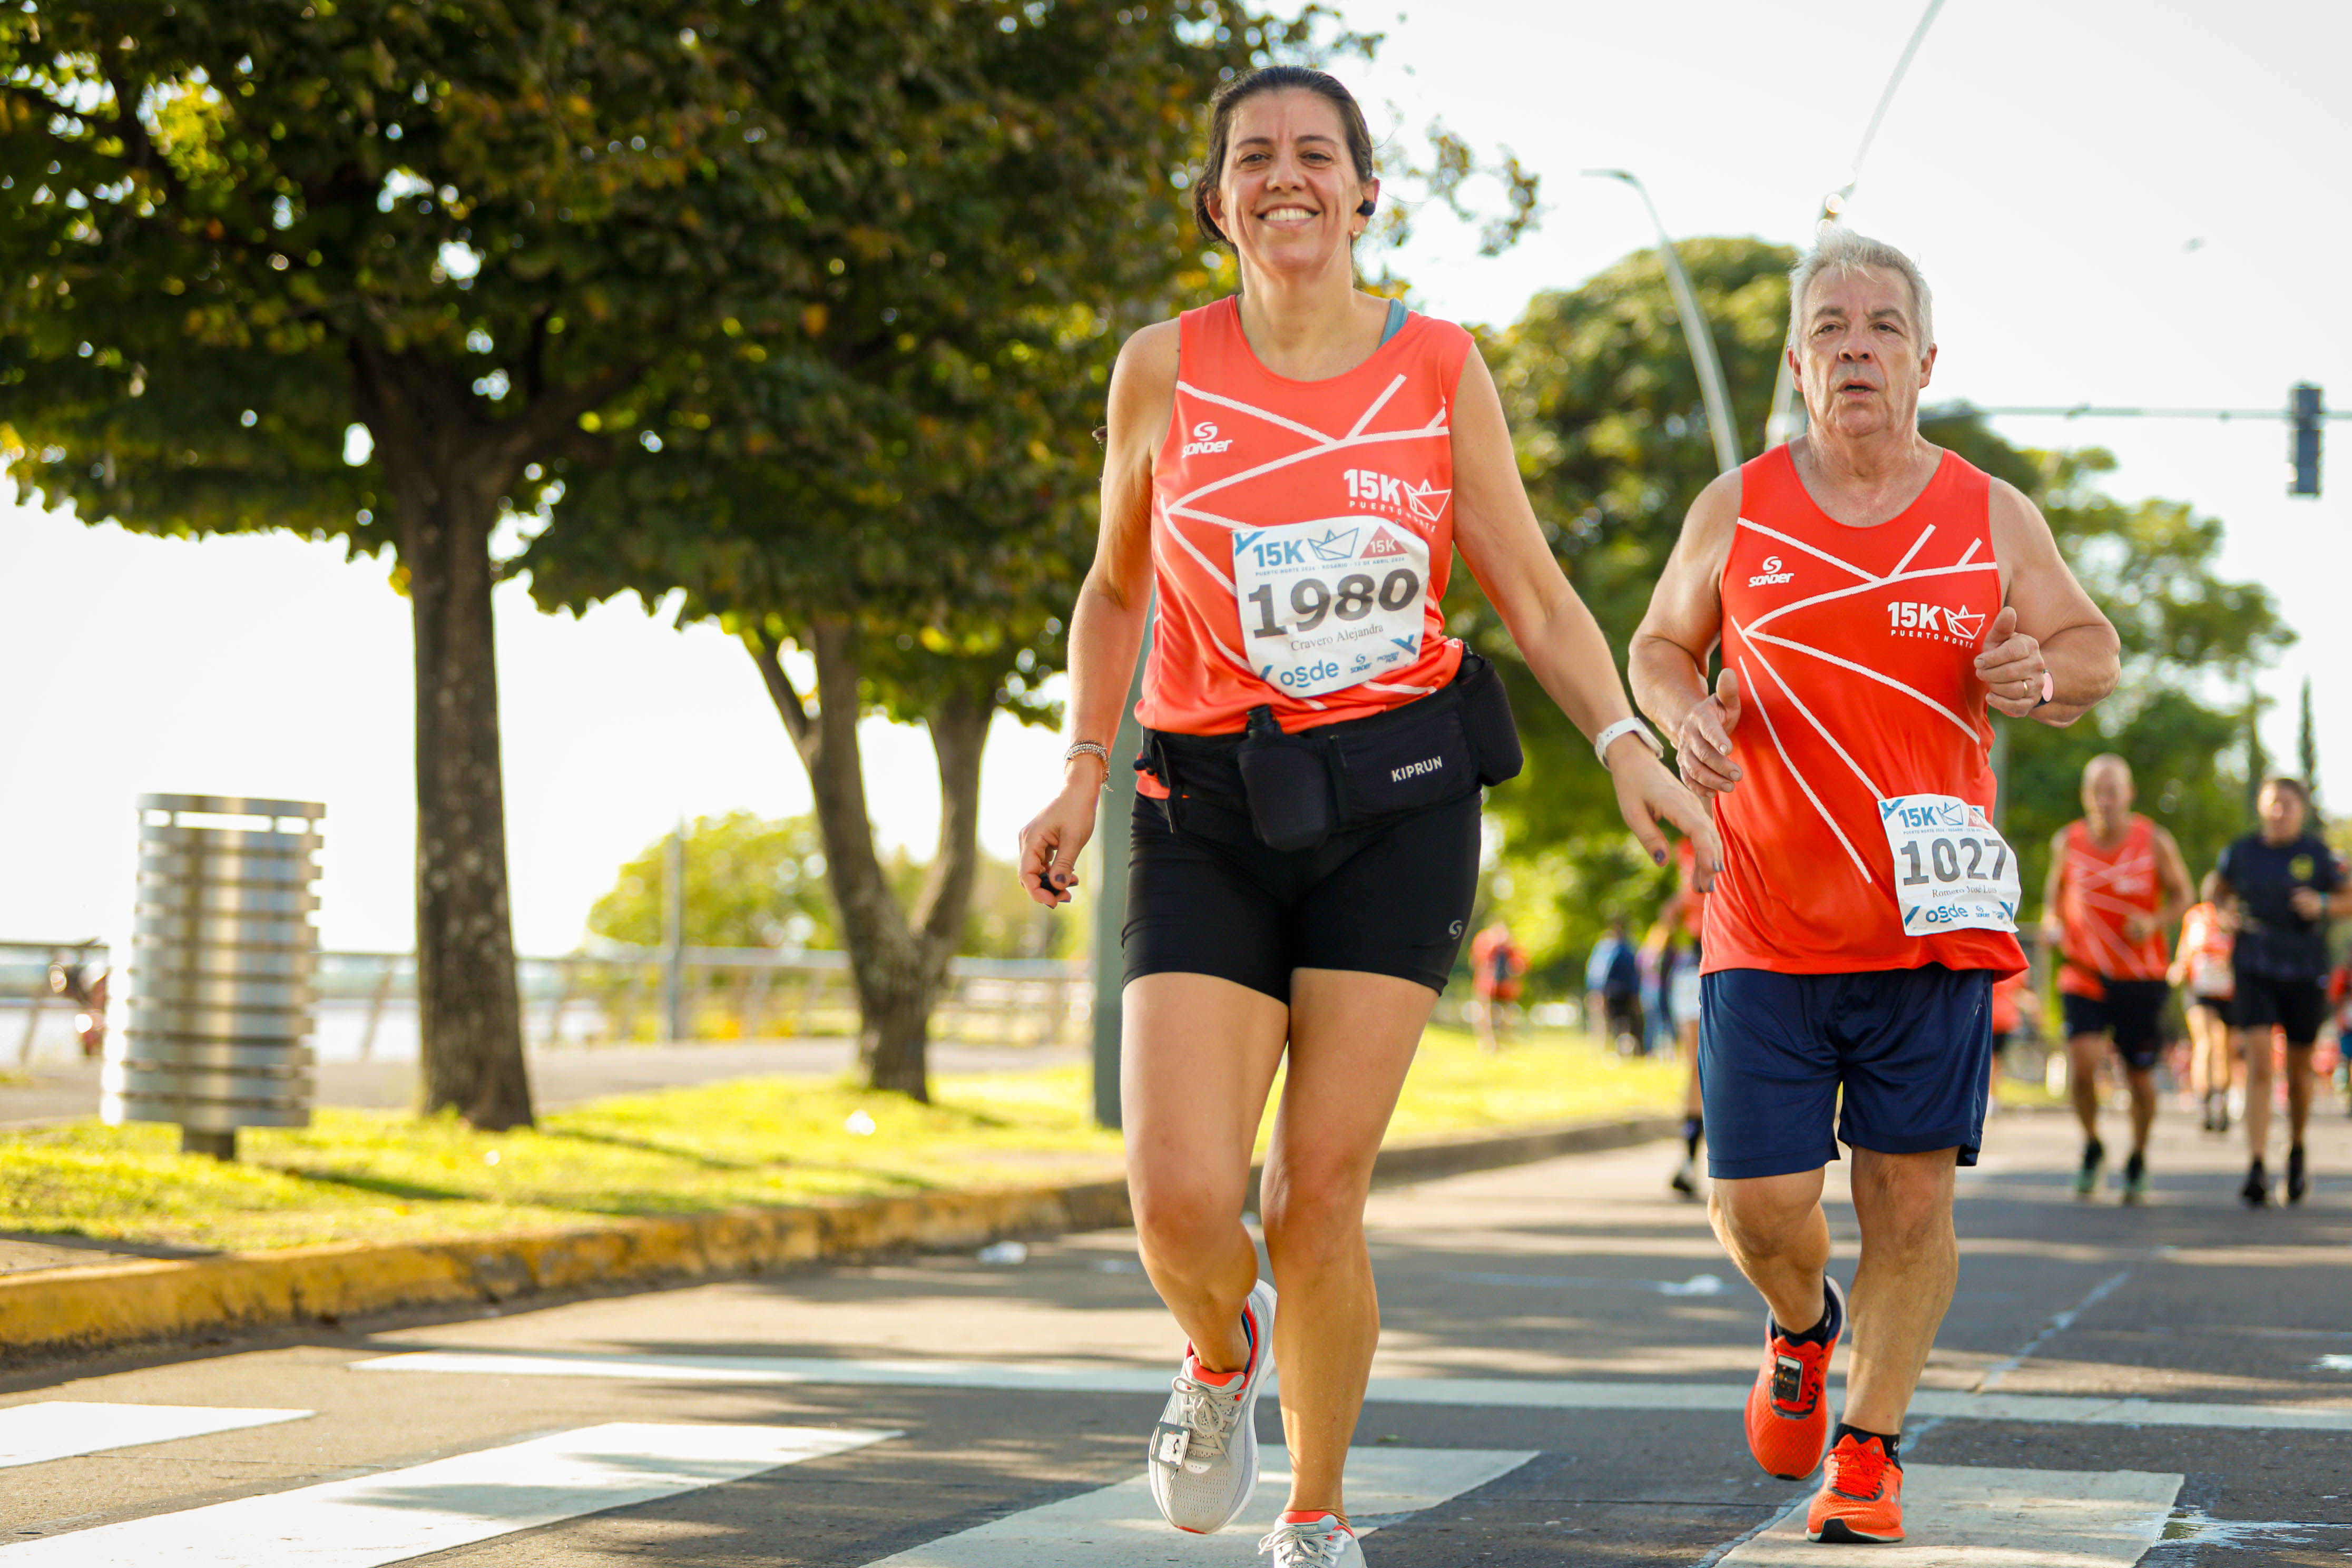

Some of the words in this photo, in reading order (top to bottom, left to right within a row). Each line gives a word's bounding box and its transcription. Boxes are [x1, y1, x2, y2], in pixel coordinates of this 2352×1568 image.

[1344, 468, 1401, 506] 15K
[1349, 500, 1402, 515] PUERTO
[1253, 539, 1306, 567] 15K
[1370, 539, 1397, 554] 15K
[1248, 568, 1420, 639] 1980
[1887, 601, 1942, 631] 15K
[1290, 636, 1334, 651] Cravero
[1337, 623, 1384, 642] Alejandra
[1890, 629, 1939, 640] PUERTO
[1943, 635, 1973, 649] NORTE
[1280, 659, 1339, 687] osde
[1391, 756, 1443, 782] KIPRUN
[1898, 806, 1938, 828] 15K
[1900, 837, 2007, 886] 1027
[1932, 889, 1965, 898] Romero
[1926, 903, 1969, 923] osde
